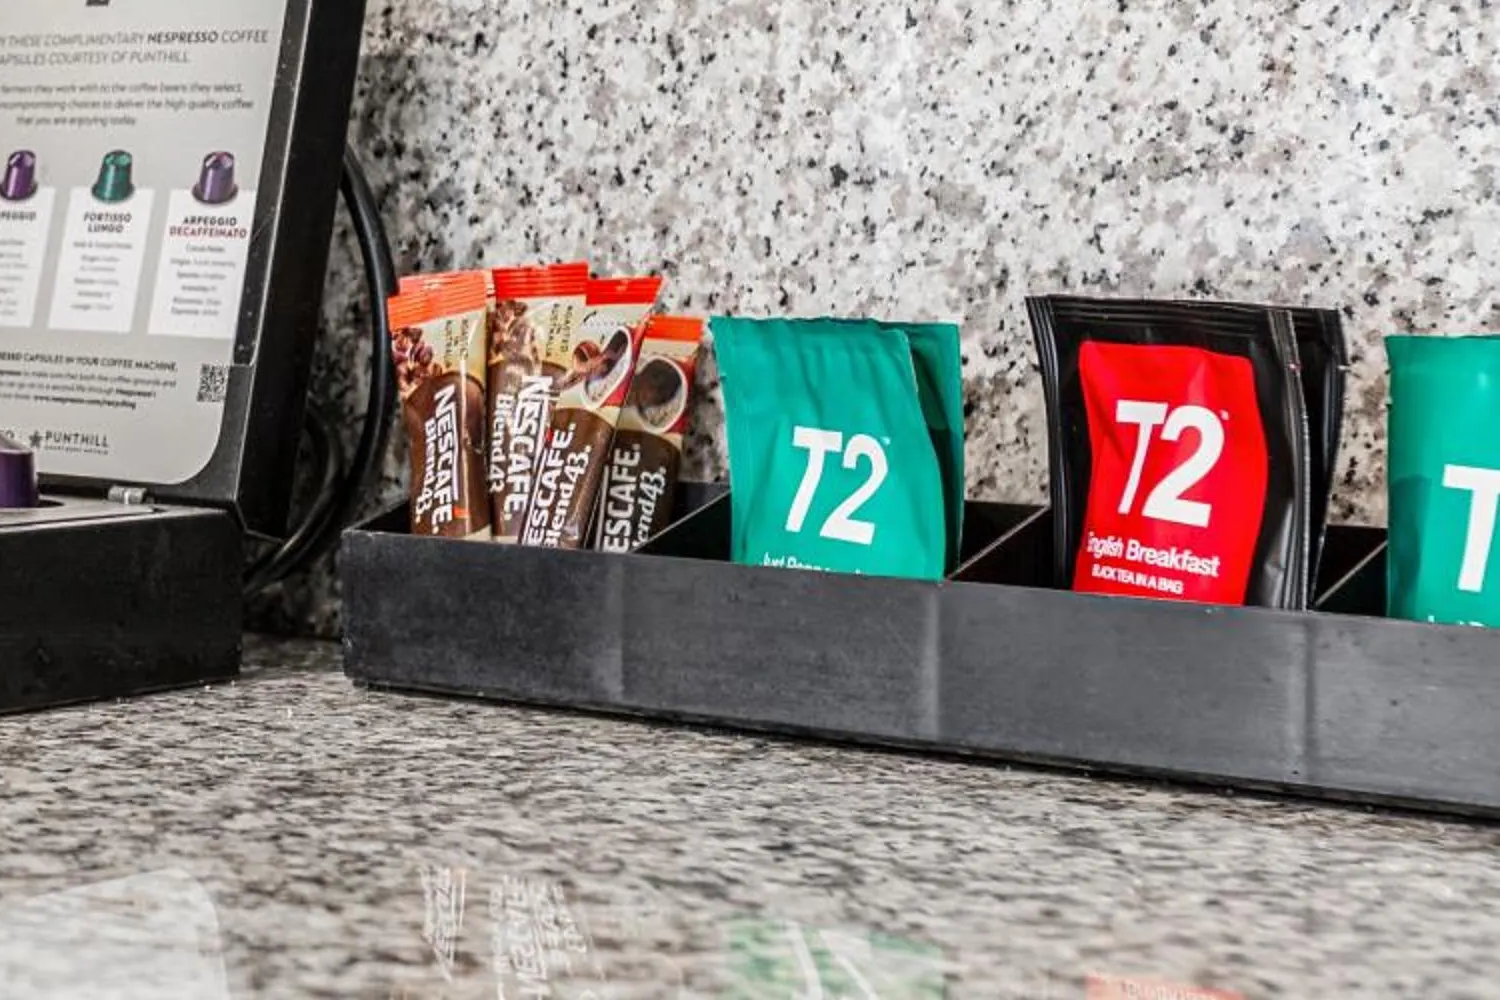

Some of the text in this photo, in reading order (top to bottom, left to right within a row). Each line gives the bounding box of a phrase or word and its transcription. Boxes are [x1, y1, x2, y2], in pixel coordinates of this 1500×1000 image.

[7, 34, 40, 48] THESE
[43, 31, 144, 48] COMPLIMENTARY
[146, 30, 219, 44] NESPRESSO
[220, 29, 268, 44] COFFEE
[48, 51, 108, 66] COURTESY
[110, 51, 127, 64] OF
[87, 223, 125, 234] LUNGO
[182, 215, 237, 226] ARPEGGIO
[169, 226, 248, 239] DECAFFEINATO
[23, 352, 63, 364] CAPSULES
[75, 356, 99, 366] YOUR
[100, 357, 133, 367] COFFEE
[45, 431, 109, 448] PUNTHILL
[1115, 400, 1226, 528] T2
[784, 425, 889, 546] T2
[1126, 539, 1221, 578] Breakfast
[1157, 577, 1184, 595] BAG
